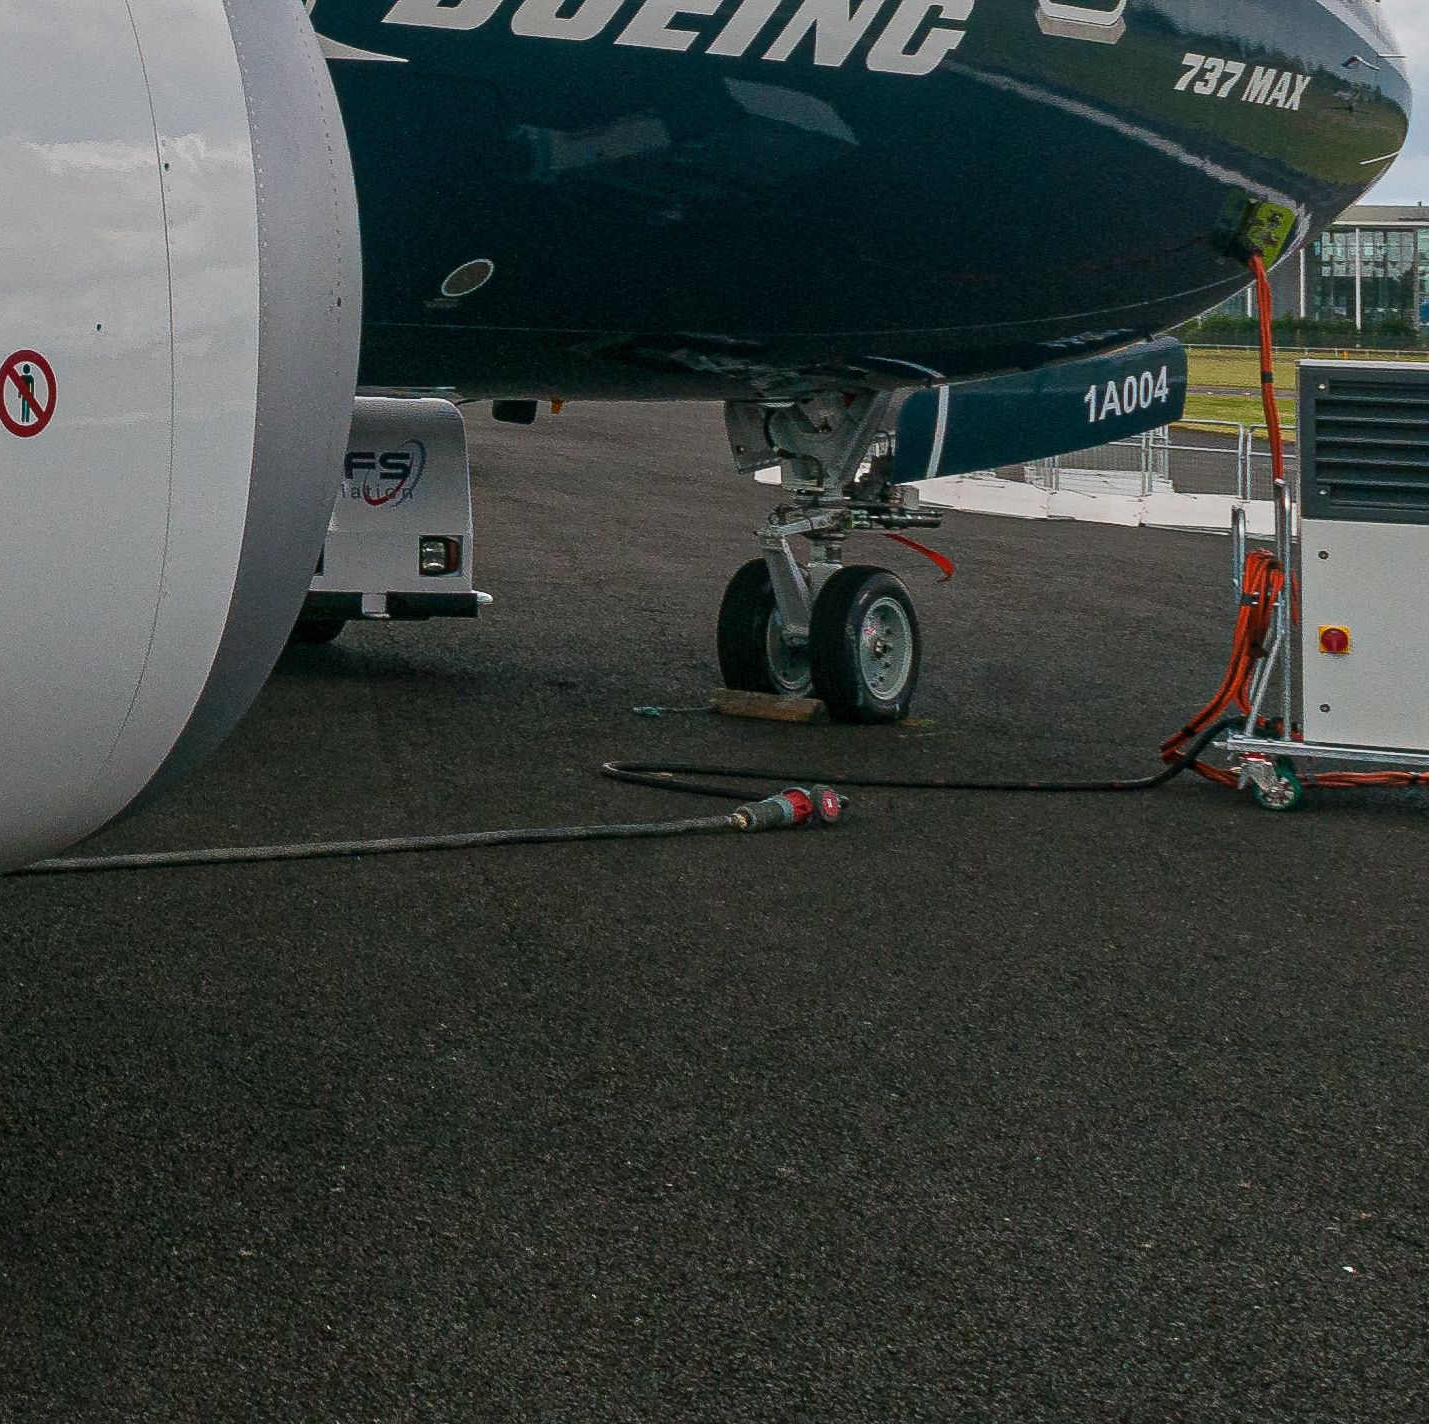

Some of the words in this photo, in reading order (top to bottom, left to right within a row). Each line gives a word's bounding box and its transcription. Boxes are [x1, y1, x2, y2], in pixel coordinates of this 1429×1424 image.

[1174, 52, 1246, 98] 737
[1241, 65, 1311, 111] MAX
[1084, 365, 1169, 423] 1A004
